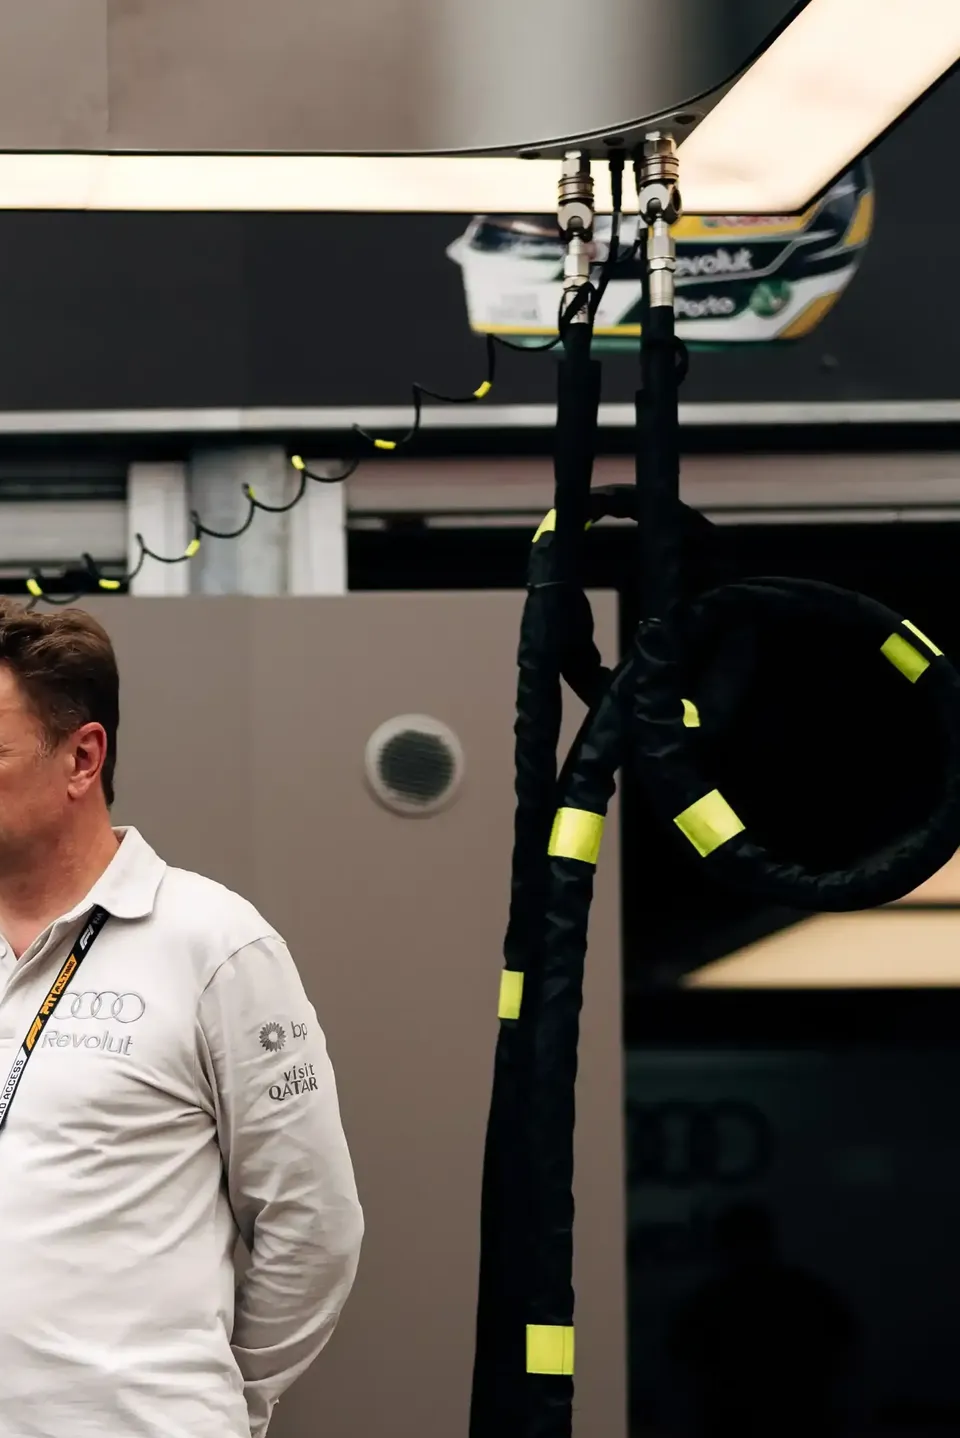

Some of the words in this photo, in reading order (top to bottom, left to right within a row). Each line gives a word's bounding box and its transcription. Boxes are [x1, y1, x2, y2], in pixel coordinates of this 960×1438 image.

[291, 1021, 308, 1040] bp
[41, 1030, 133, 1056] Revolut
[2, 1060, 25, 1100] ACCESS
[284, 1063, 315, 1081] visit
[269, 1077, 319, 1101] QATAR
